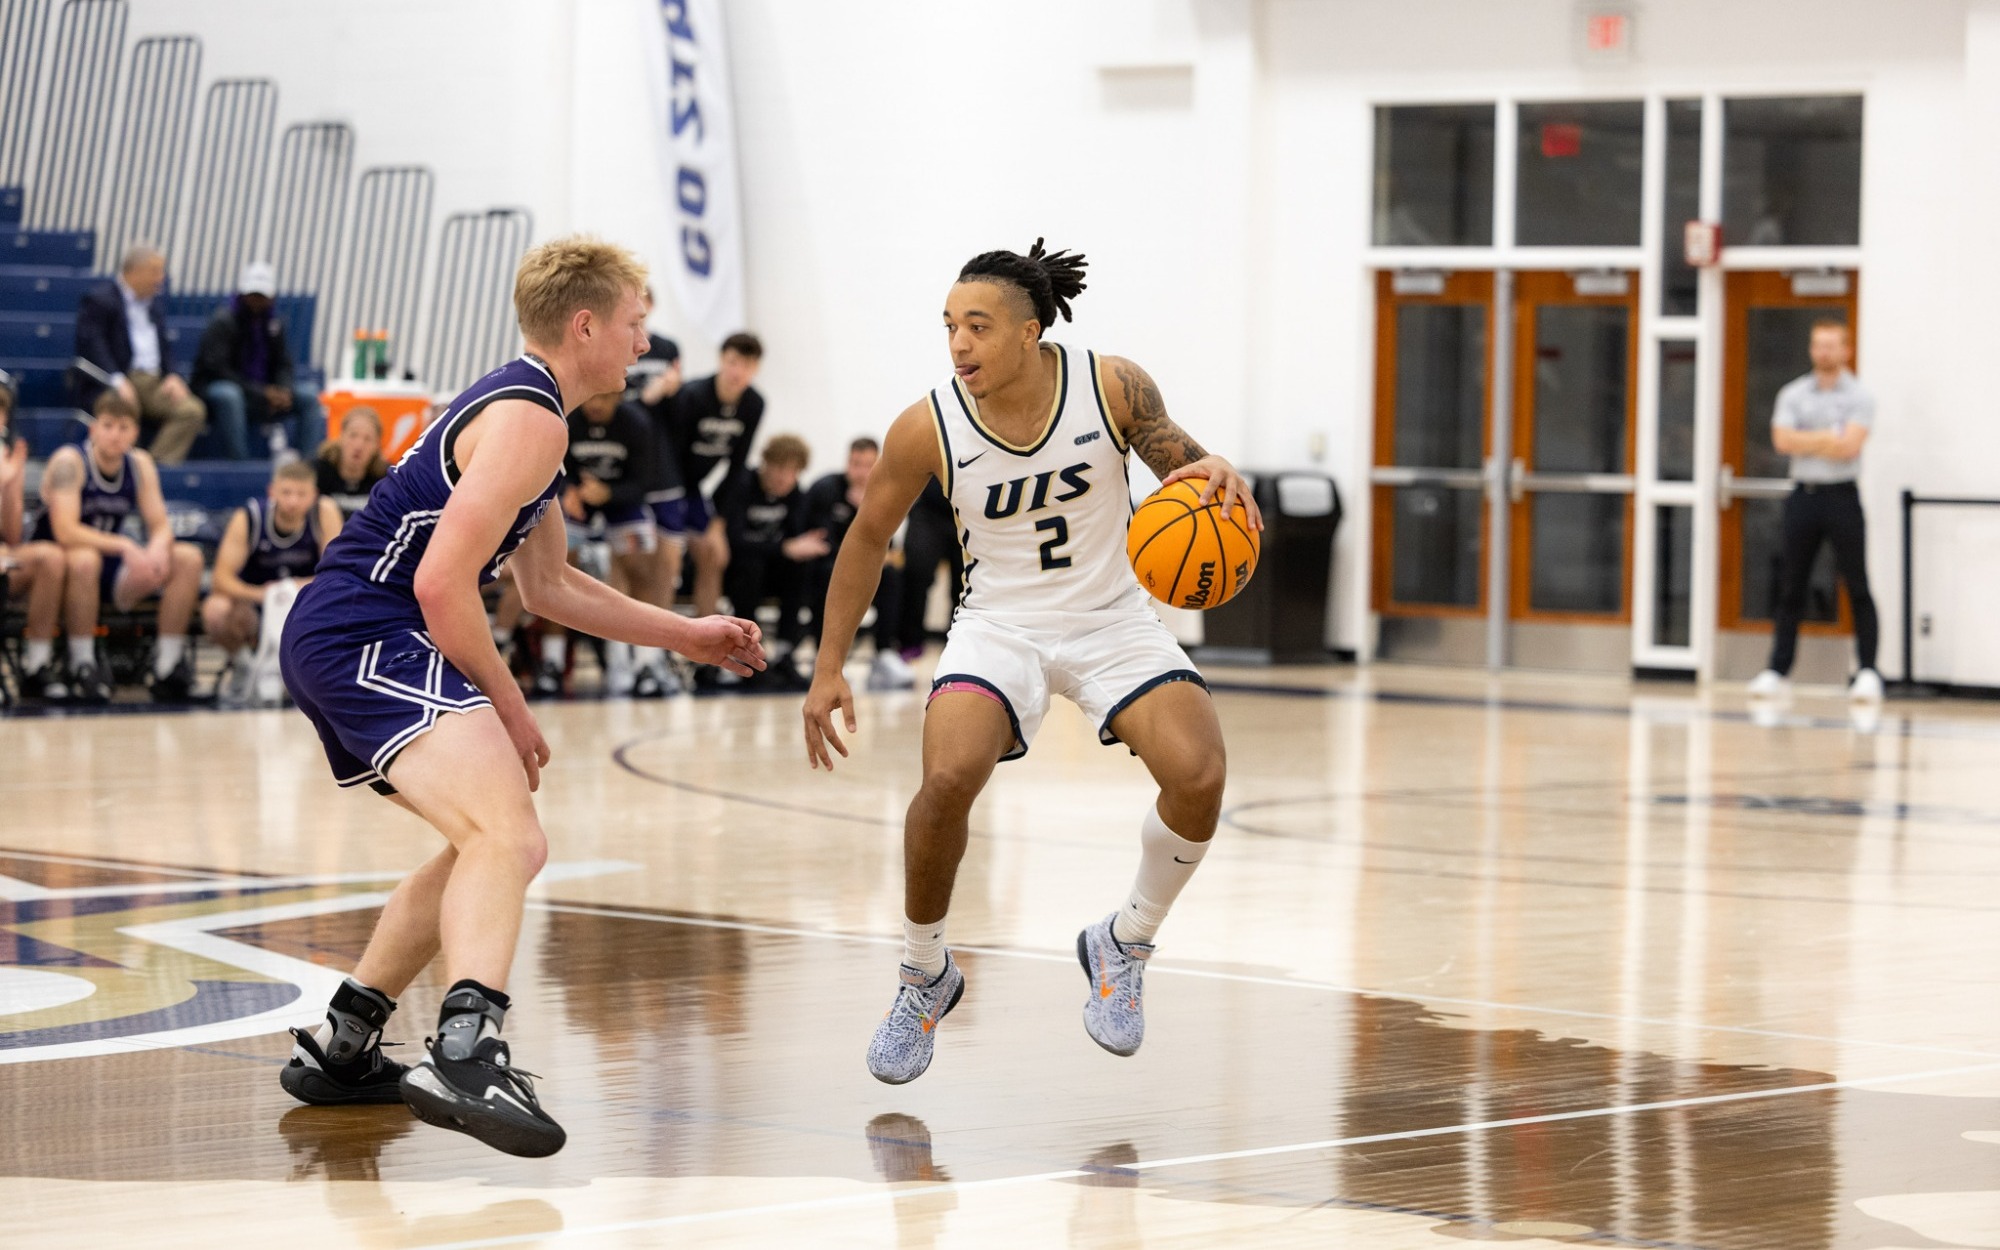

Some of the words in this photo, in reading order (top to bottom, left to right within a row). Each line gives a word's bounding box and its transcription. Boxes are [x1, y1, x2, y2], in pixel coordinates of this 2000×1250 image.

[676, 164, 711, 278] GO
[984, 462, 1093, 519] UIS
[1035, 515, 1072, 571] 2
